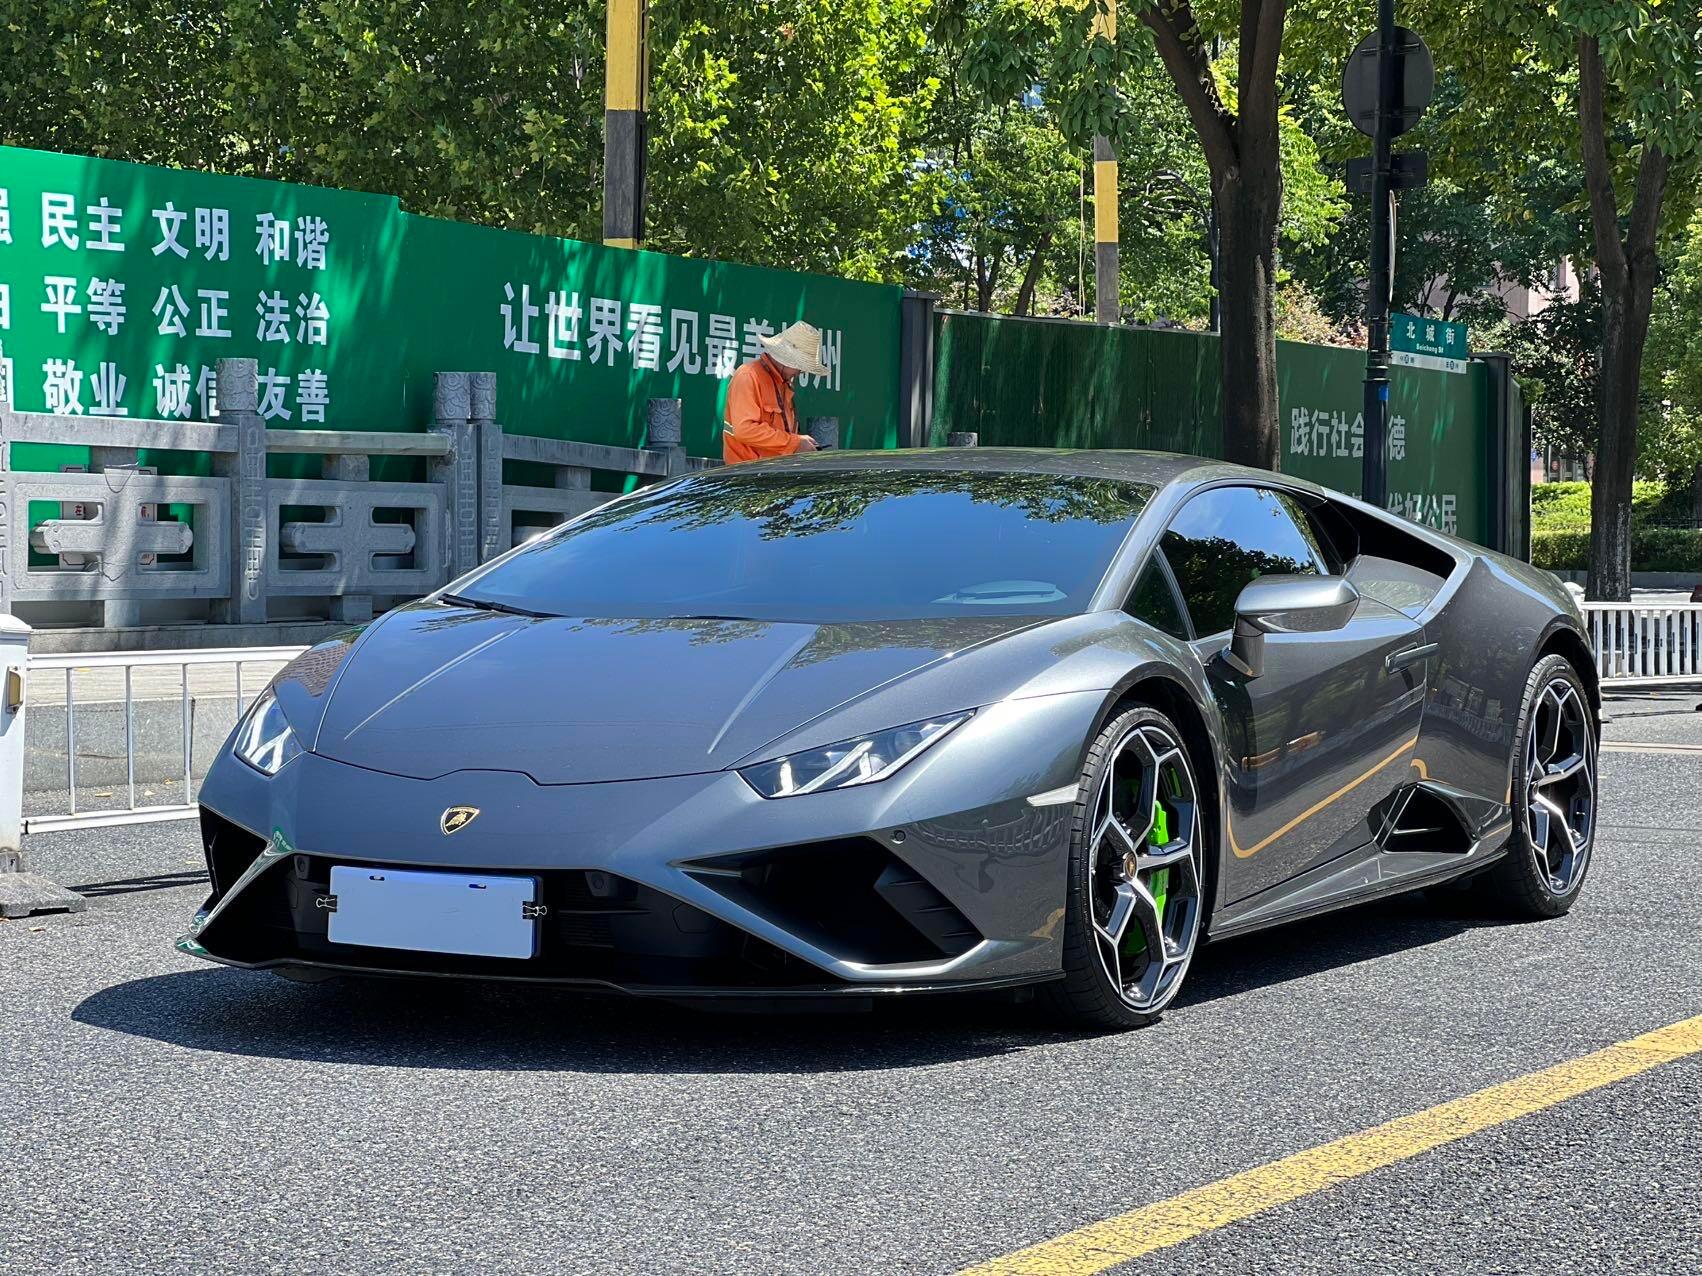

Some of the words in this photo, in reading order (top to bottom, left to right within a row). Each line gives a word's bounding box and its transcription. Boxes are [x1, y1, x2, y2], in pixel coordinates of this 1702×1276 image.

[41, 191, 126, 252] 民主
[151, 201, 231, 262] 文明
[255, 212, 330, 271] 和谐
[40, 275, 127, 336] 平等
[151, 284, 232, 339] 公正
[255, 290, 331, 346] 法治
[500, 281, 842, 392] 让世界看见最美州
[1406, 321, 1455, 345] 北城街
[41, 357, 129, 416] 敬业
[256, 367, 330, 423] 友善
[1290, 406, 1406, 461] 践行社会德
